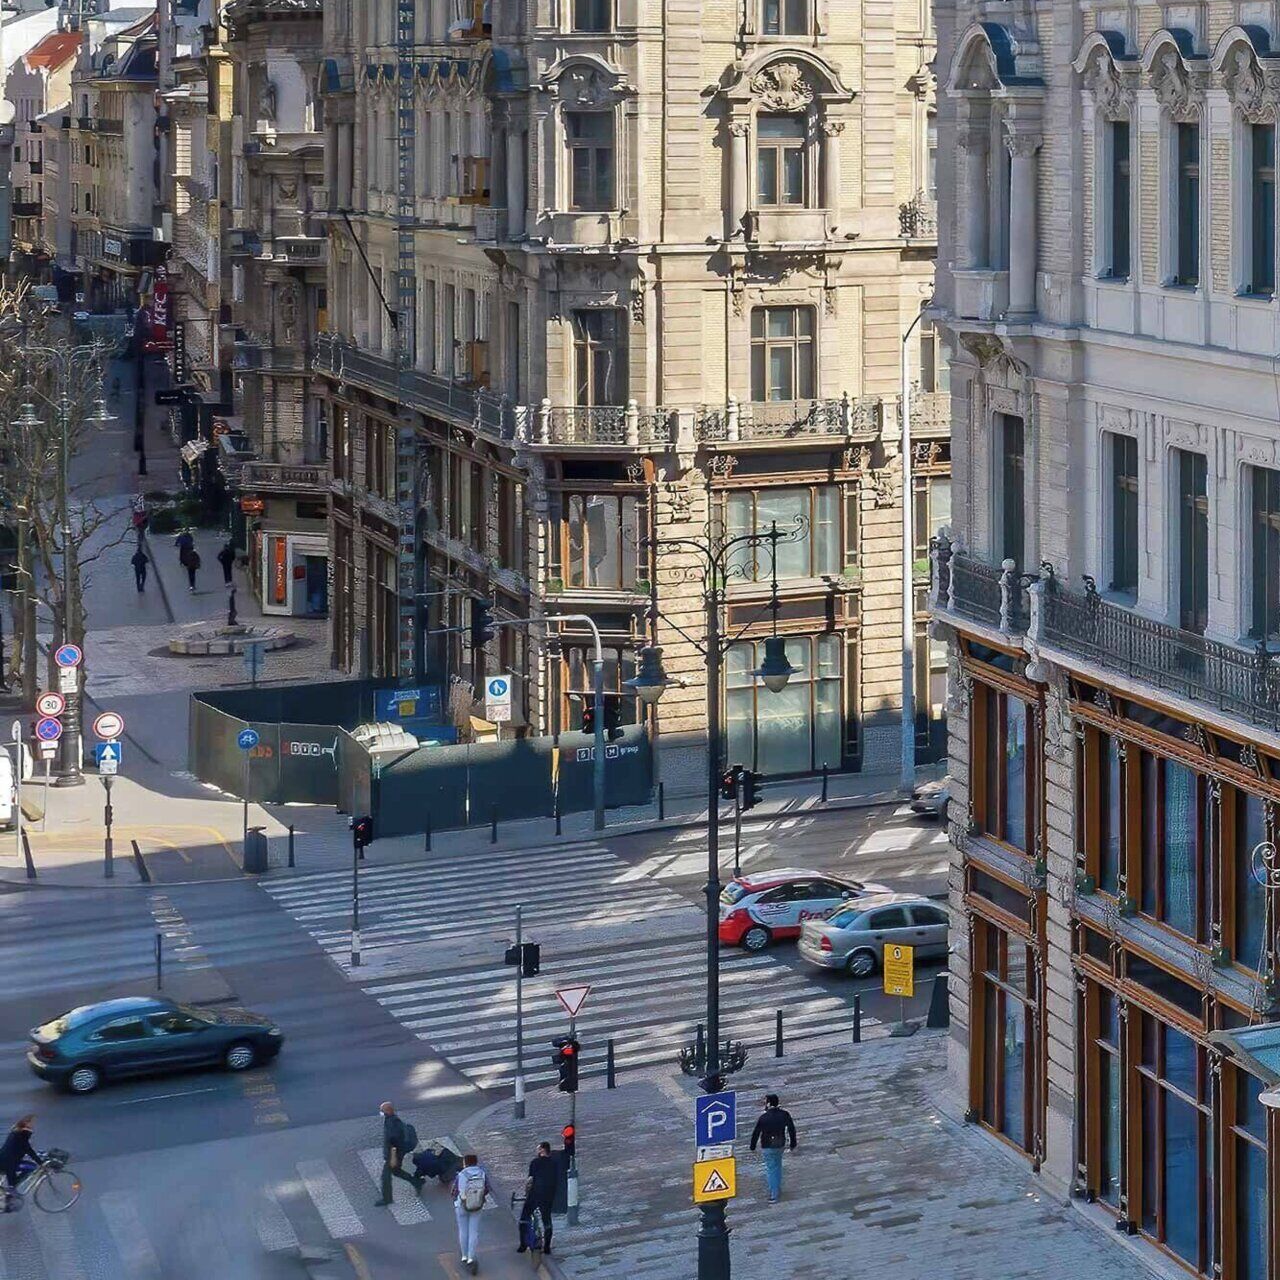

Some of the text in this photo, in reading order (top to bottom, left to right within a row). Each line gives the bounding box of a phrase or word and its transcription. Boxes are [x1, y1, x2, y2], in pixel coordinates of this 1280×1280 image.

[154, 293, 167, 326] KFC
[44, 700, 58, 710] 30
[707, 1110, 727, 1139] P
